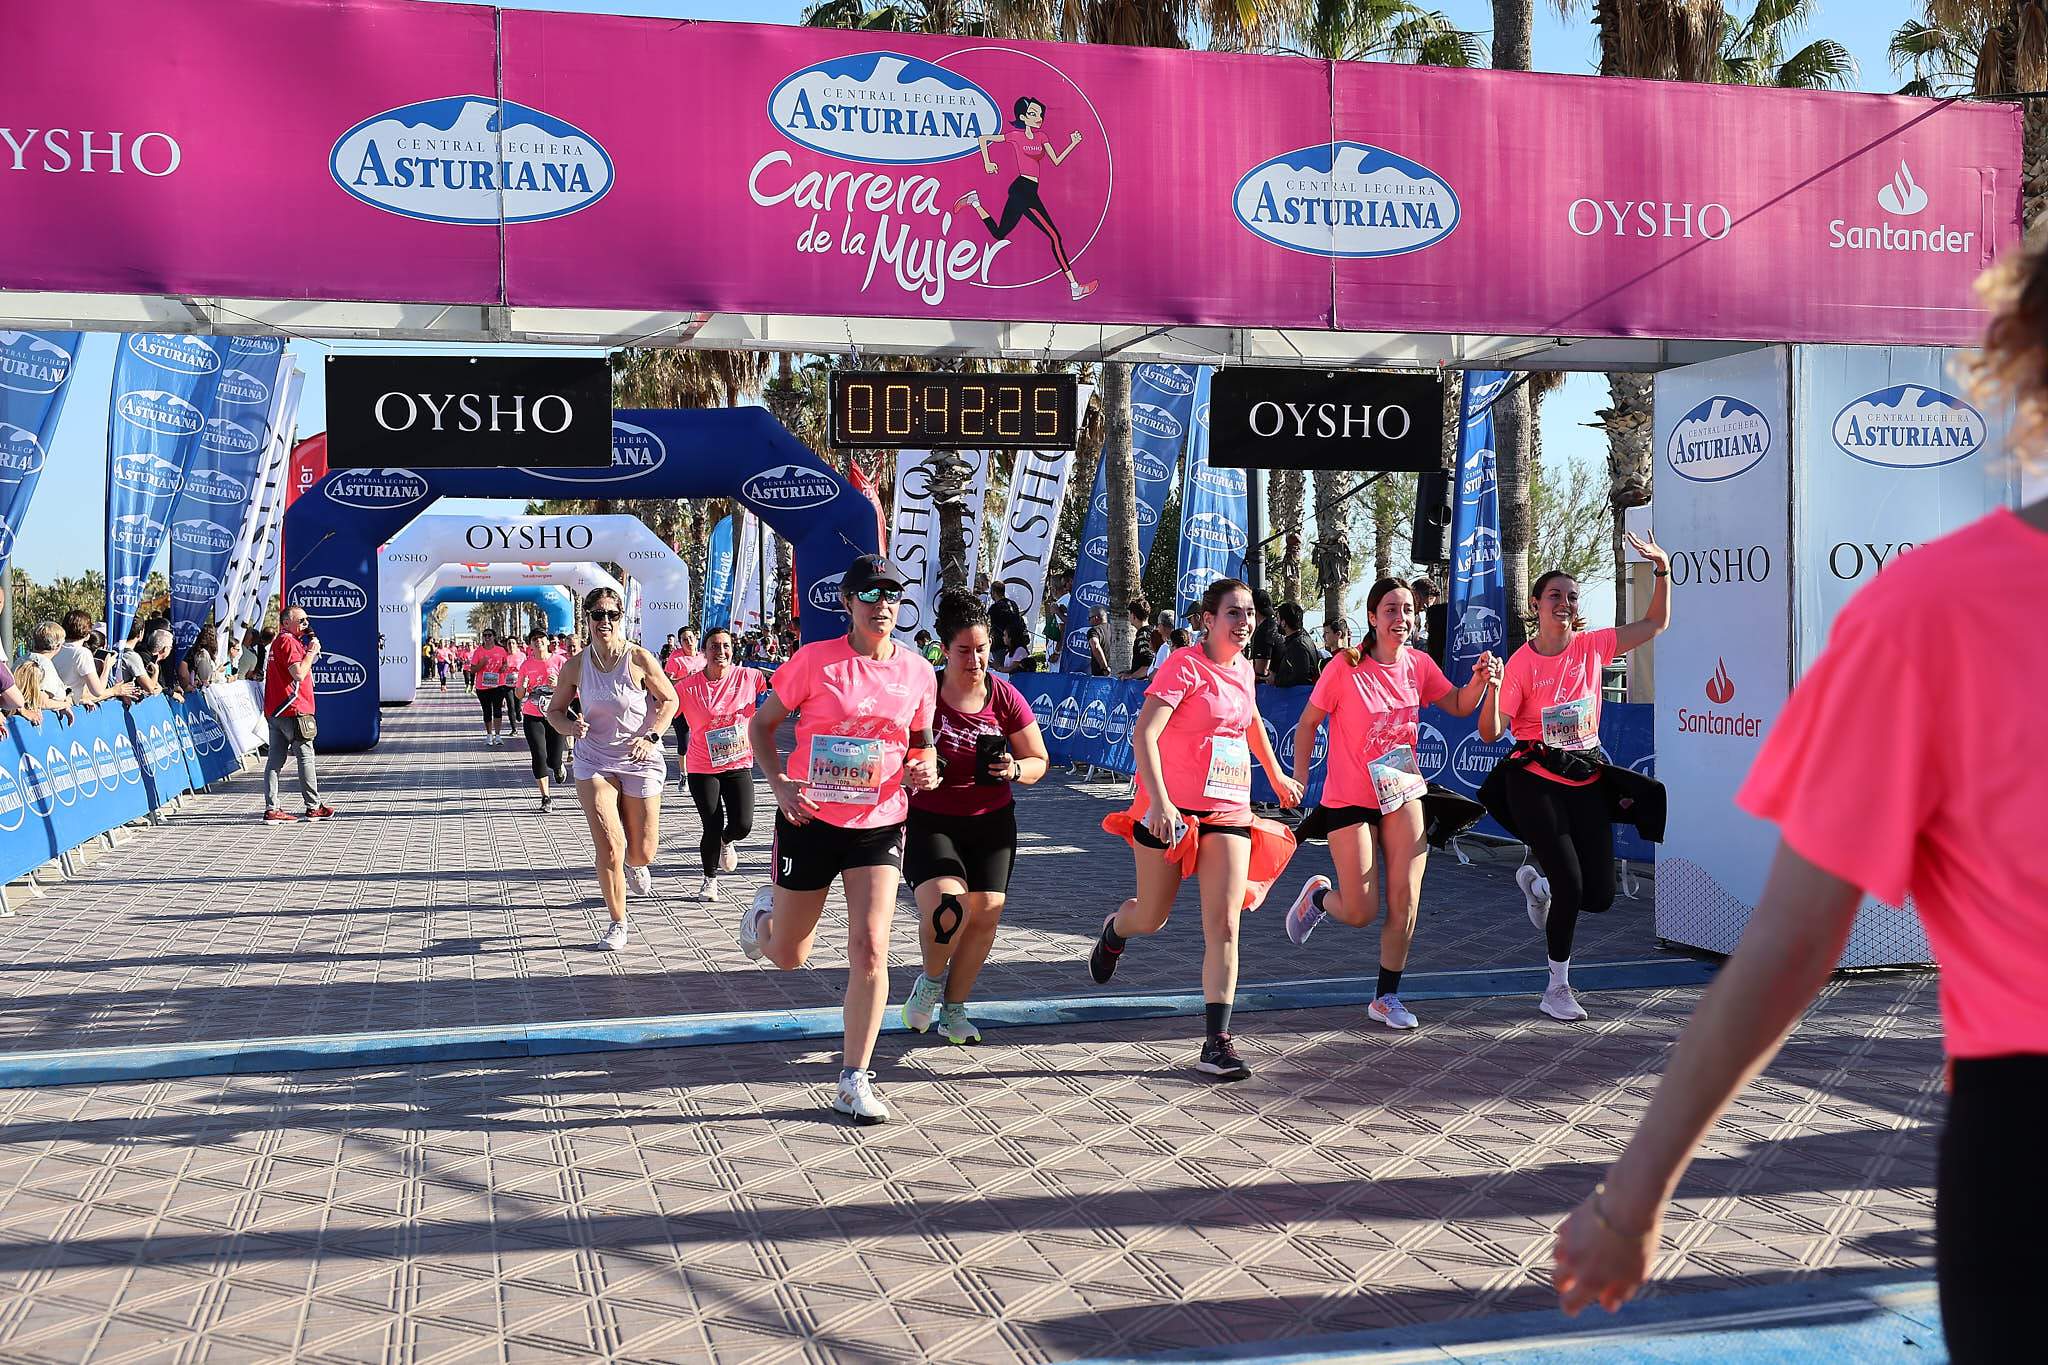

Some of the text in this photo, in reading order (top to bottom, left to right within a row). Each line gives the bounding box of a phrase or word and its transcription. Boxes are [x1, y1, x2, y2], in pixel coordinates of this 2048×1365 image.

[823, 87, 977, 106] CENTRAL LECHERA
[786, 88, 983, 139] ASTURIANA
[0, 128, 181, 177] YSHO
[397, 138, 486, 153] CENTRAL
[352, 139, 594, 193] ASTURIANA
[748, 150, 942, 216] Carrera
[1286, 179, 1436, 196] CENTRAL LECHERA
[1250, 181, 1444, 230] ASTURIANA
[1567, 197, 1733, 242] OYSHO
[1828, 217, 1975, 255] Santander
[796, 211, 1014, 306] de la Mujer
[135, 335, 213, 371] ASTURIANA
[1141, 367, 1190, 393] ASTURIANA
[122, 398, 198, 432] ASTURIANA
[374, 391, 573, 434] OYSHO
[848, 384, 1058, 436] 00:42:25
[1248, 401, 1411, 440] OYSHO
[1867, 413, 1916, 423] CENTRAL
[1133, 413, 1177, 436] STURIANA
[1687, 419, 1759, 438] CENTRAL LECHERA
[1844, 414, 1975, 448] ASTURIANA
[1674, 431, 1763, 466] ASTURIANA
[330, 479, 421, 499] ASTURIANA
[751, 481, 835, 500] ASTURIANA
[172, 526, 231, 549] ASTURIANA
[465, 524, 593, 550] OYSHO
[1188, 524, 1241, 547] ASTURIANA
[388, 553, 428, 563] OYSHO
[628, 551, 666, 560] OYSHO
[1670, 544, 1770, 586] OYSHO
[291, 591, 362, 608] ASTURIANA
[379, 604, 409, 613] YSHO
[648, 601, 684, 611] OYSHO
[1079, 588, 1110, 606] ASTUR
[379, 655, 409, 665] YSHO
[1678, 708, 1762, 738] Santander
